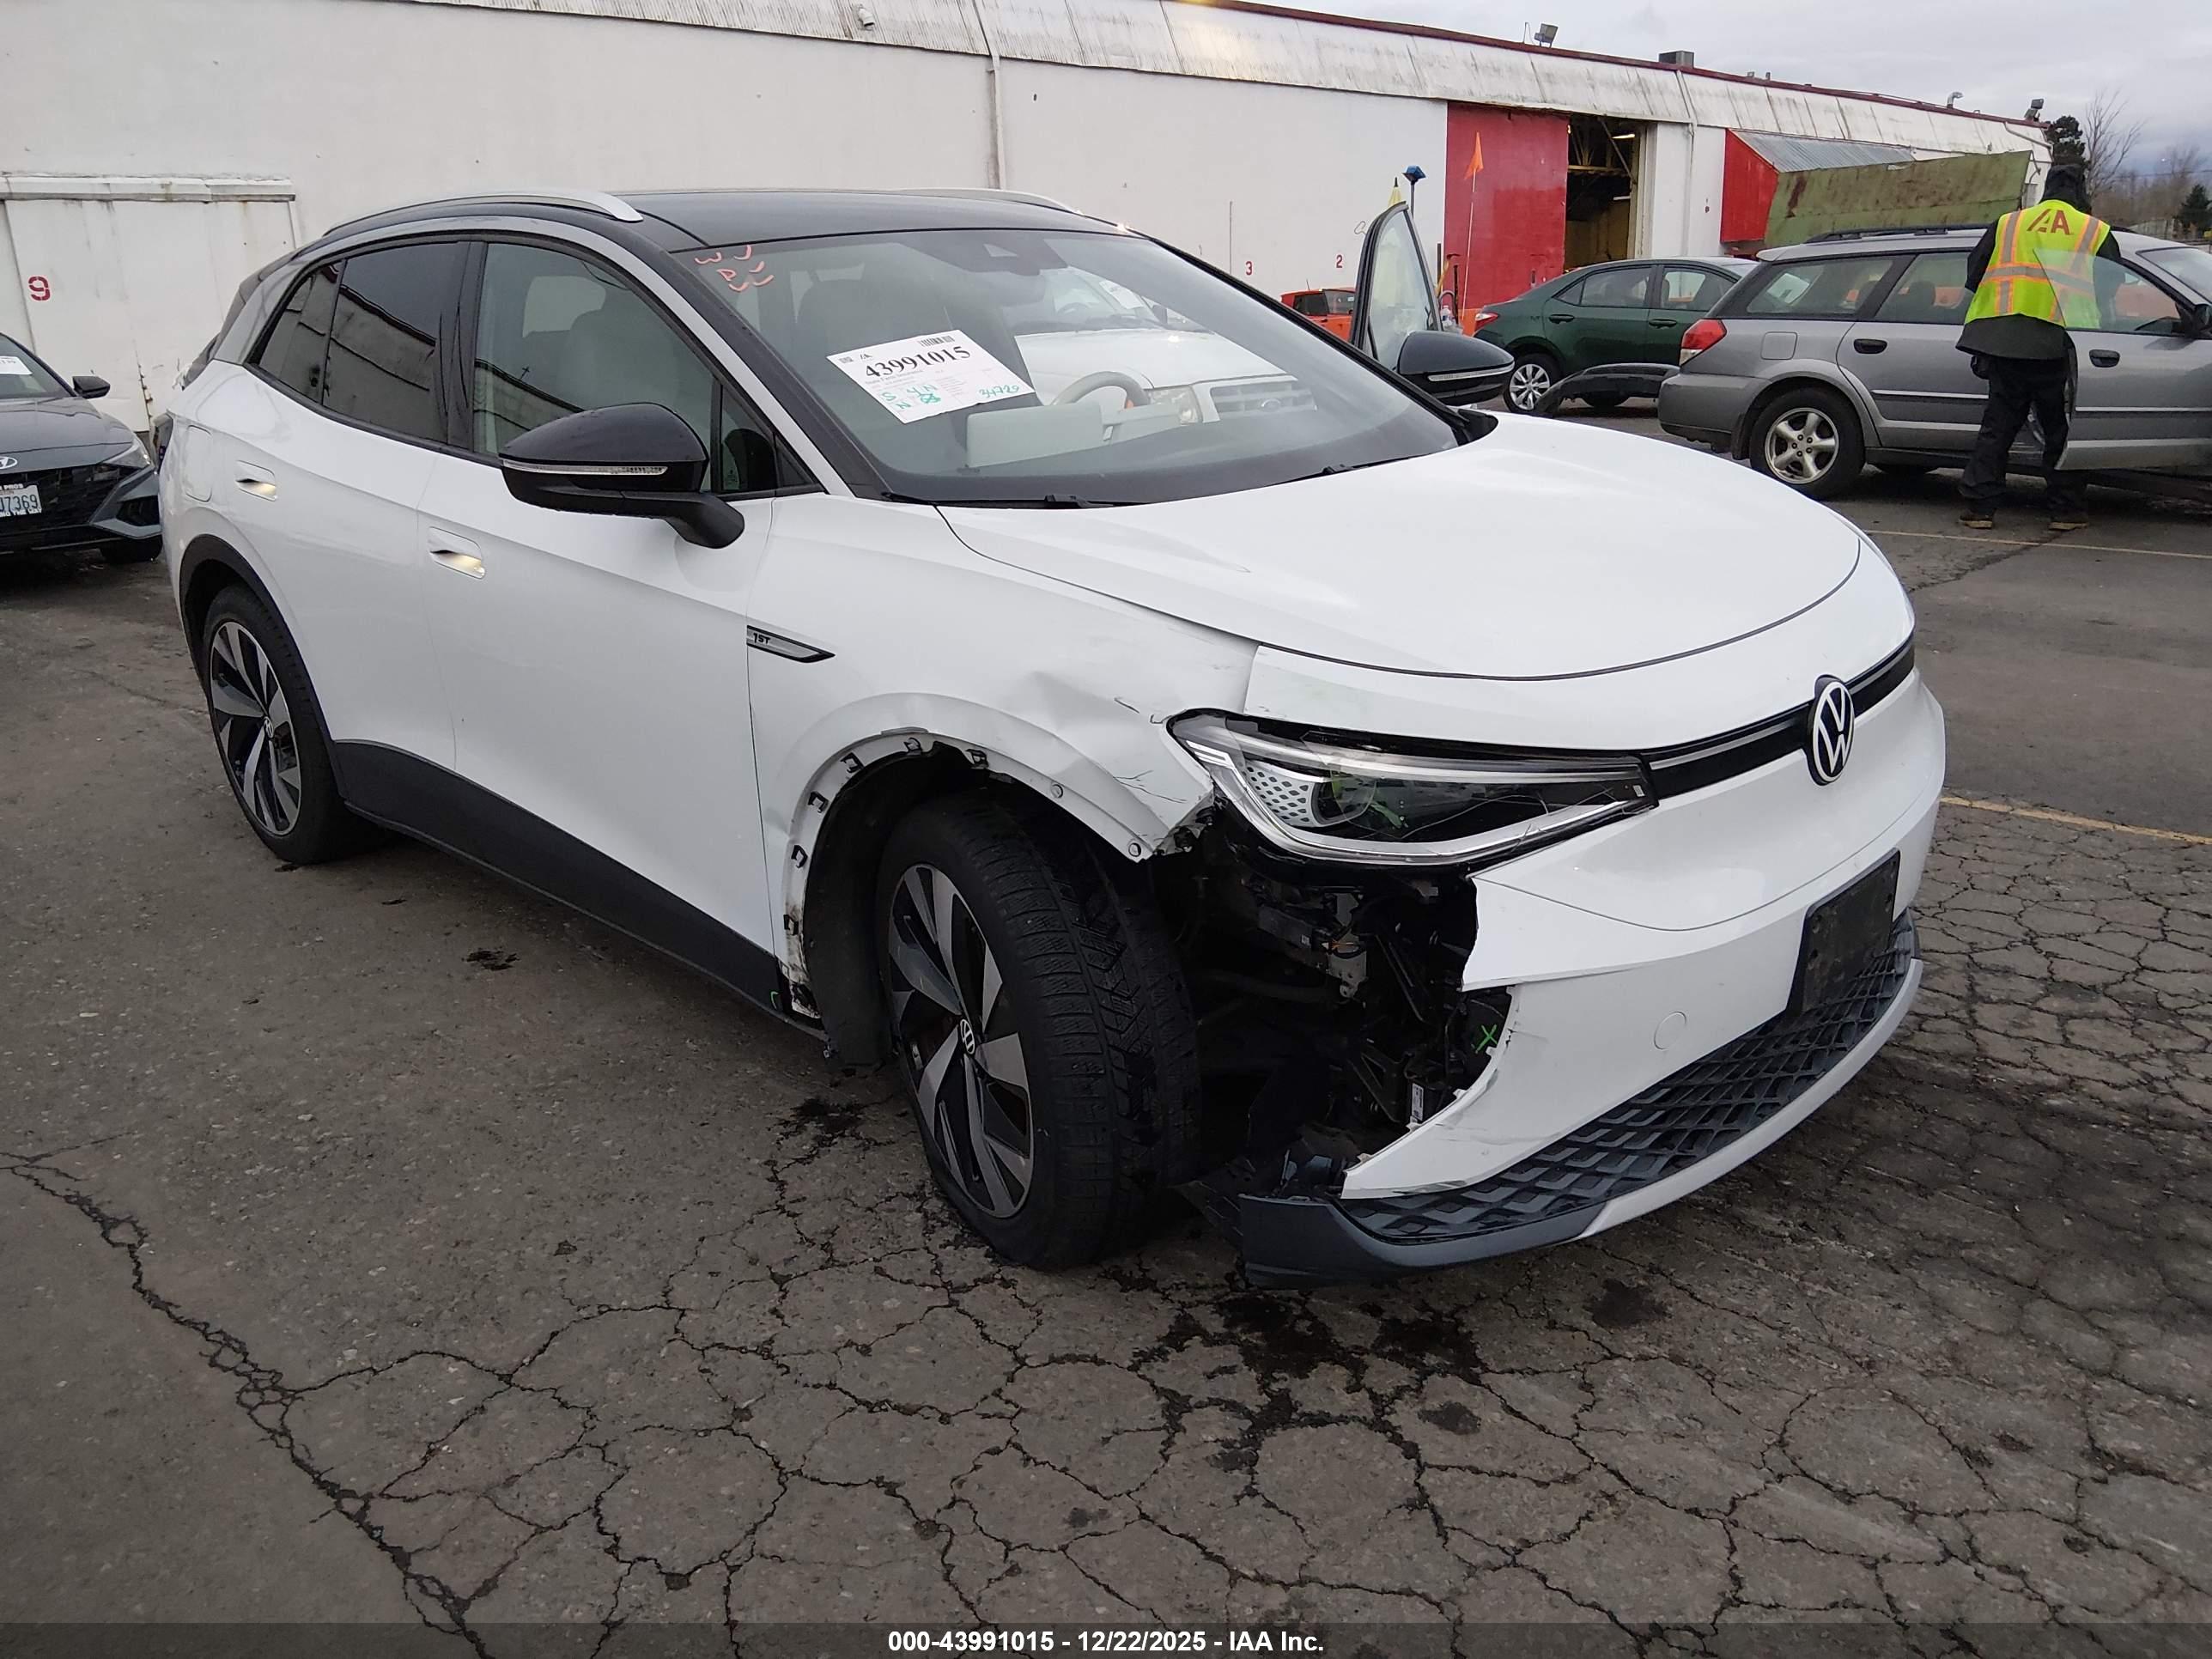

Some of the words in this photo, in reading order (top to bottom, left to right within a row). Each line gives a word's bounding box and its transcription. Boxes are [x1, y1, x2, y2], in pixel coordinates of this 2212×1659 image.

[1245, 260, 1253, 276] 3
[1336, 254, 1343, 269] 2
[28, 276, 51, 301] 9
[866, 346, 970, 376] 43991015
